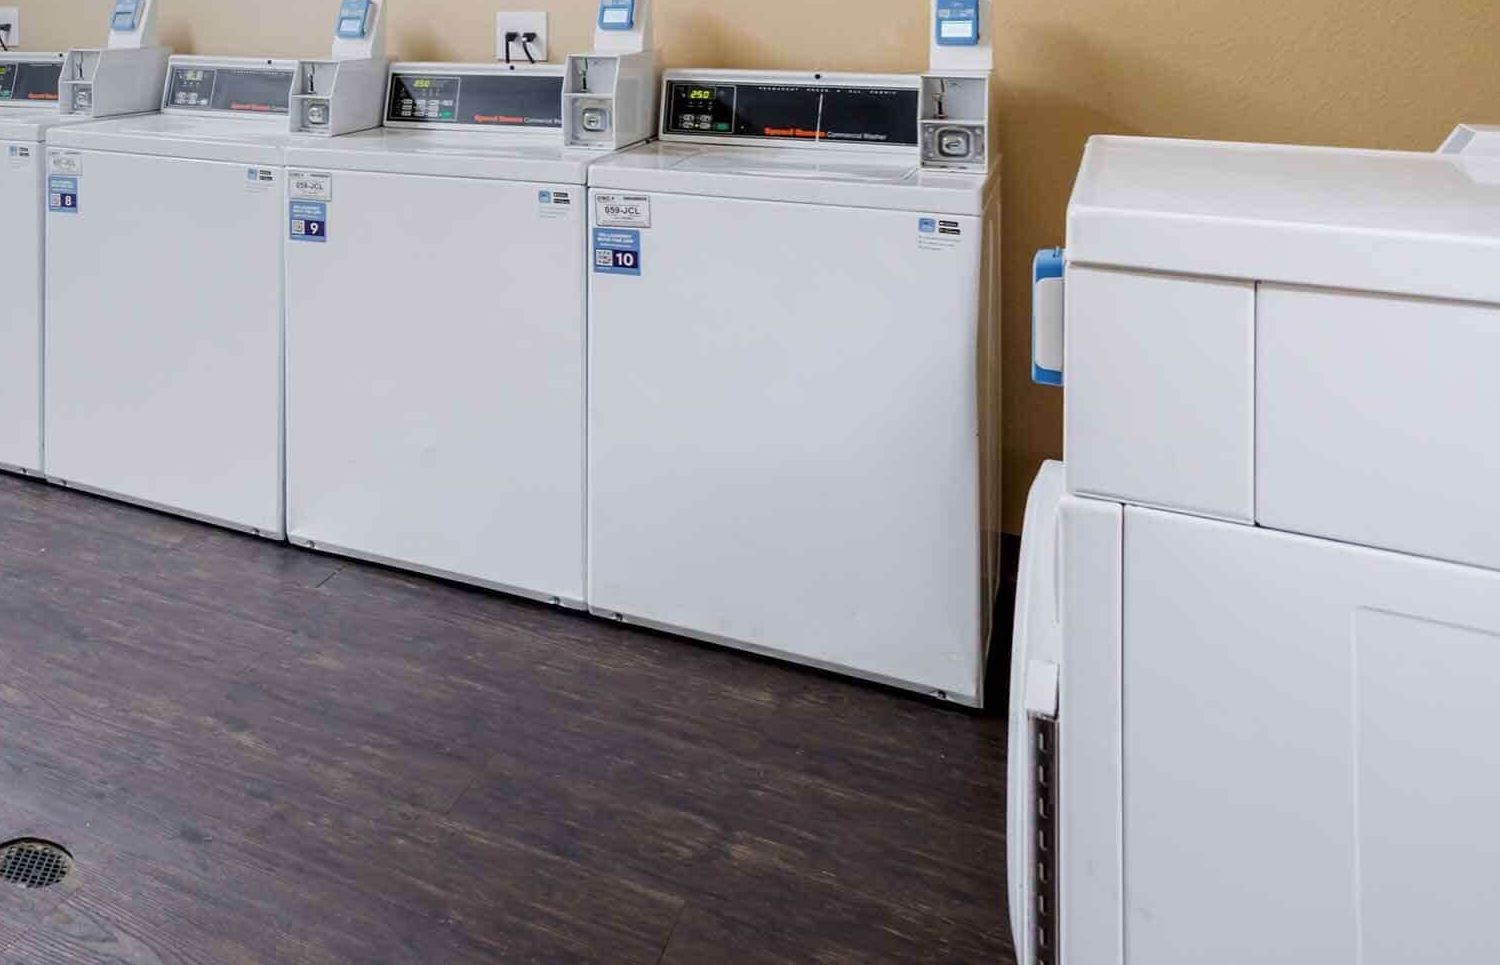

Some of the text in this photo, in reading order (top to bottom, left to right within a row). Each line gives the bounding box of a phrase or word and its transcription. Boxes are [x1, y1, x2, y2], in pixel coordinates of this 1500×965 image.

[691, 90, 710, 99] 250
[65, 195, 72, 206] 8
[604, 206, 641, 215] 059-JCL
[310, 222, 319, 234] 9
[615, 252, 634, 267] 10
